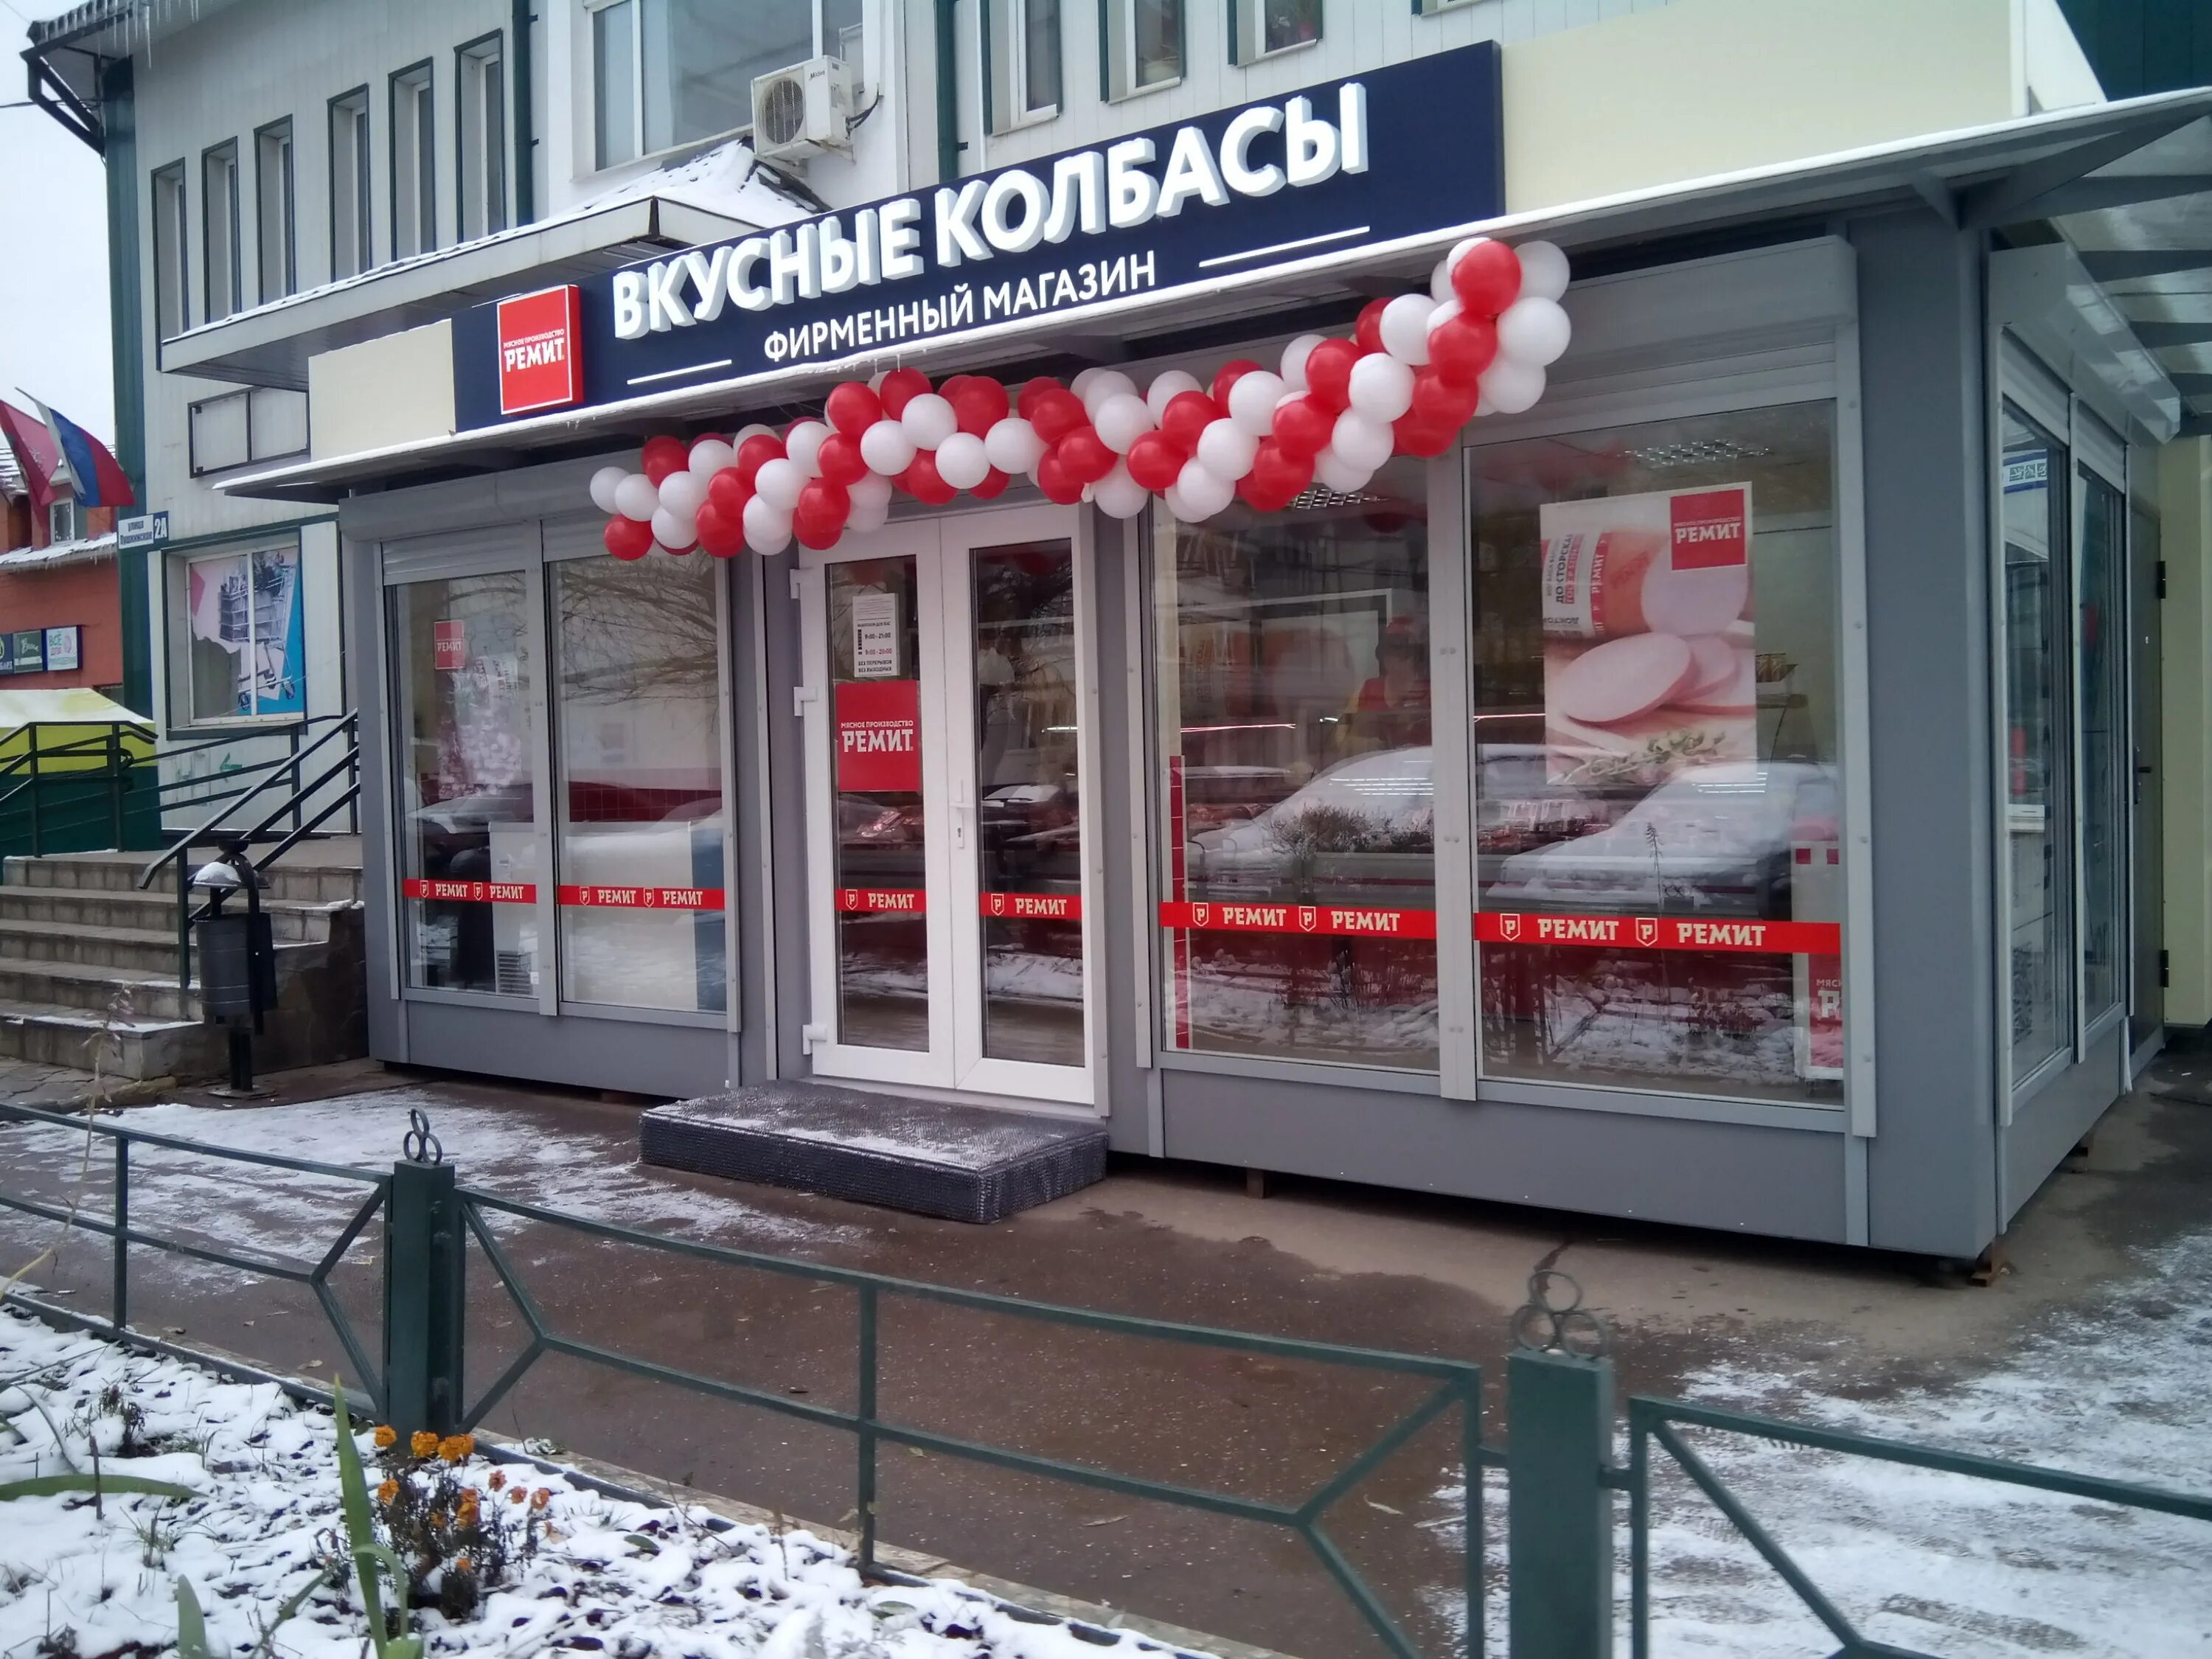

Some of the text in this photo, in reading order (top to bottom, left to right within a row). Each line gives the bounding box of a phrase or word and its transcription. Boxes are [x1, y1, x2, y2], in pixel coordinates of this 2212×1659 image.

[613, 83, 1369, 340] ВКУСНЫЕ КОЛБАСЫ
[765, 250, 1155, 361] ФИРМЕННЫЙ МАГАЗИН
[504, 337, 564, 372] РЕМИТ
[1674, 521, 1741, 544] РЕМИТ
[436, 641, 462, 652] РЕМИТ
[841, 728, 914, 753] РЕМИТ
[435, 883, 468, 897] РЕМИТ
[490, 885, 524, 899] РЕМИТ
[597, 890, 636, 904] РЕМИТ
[663, 891, 703, 905] РЕМИТ
[868, 892, 915, 909] РЕМИТ
[1015, 897, 1067, 915] РЕМИТ
[1222, 906, 1287, 927] РЕМИТ
[1330, 910, 1401, 932] РЕМИТ
[1537, 918, 1619, 940] РЕМИТ
[1676, 922, 1766, 947] РЕМИТ
